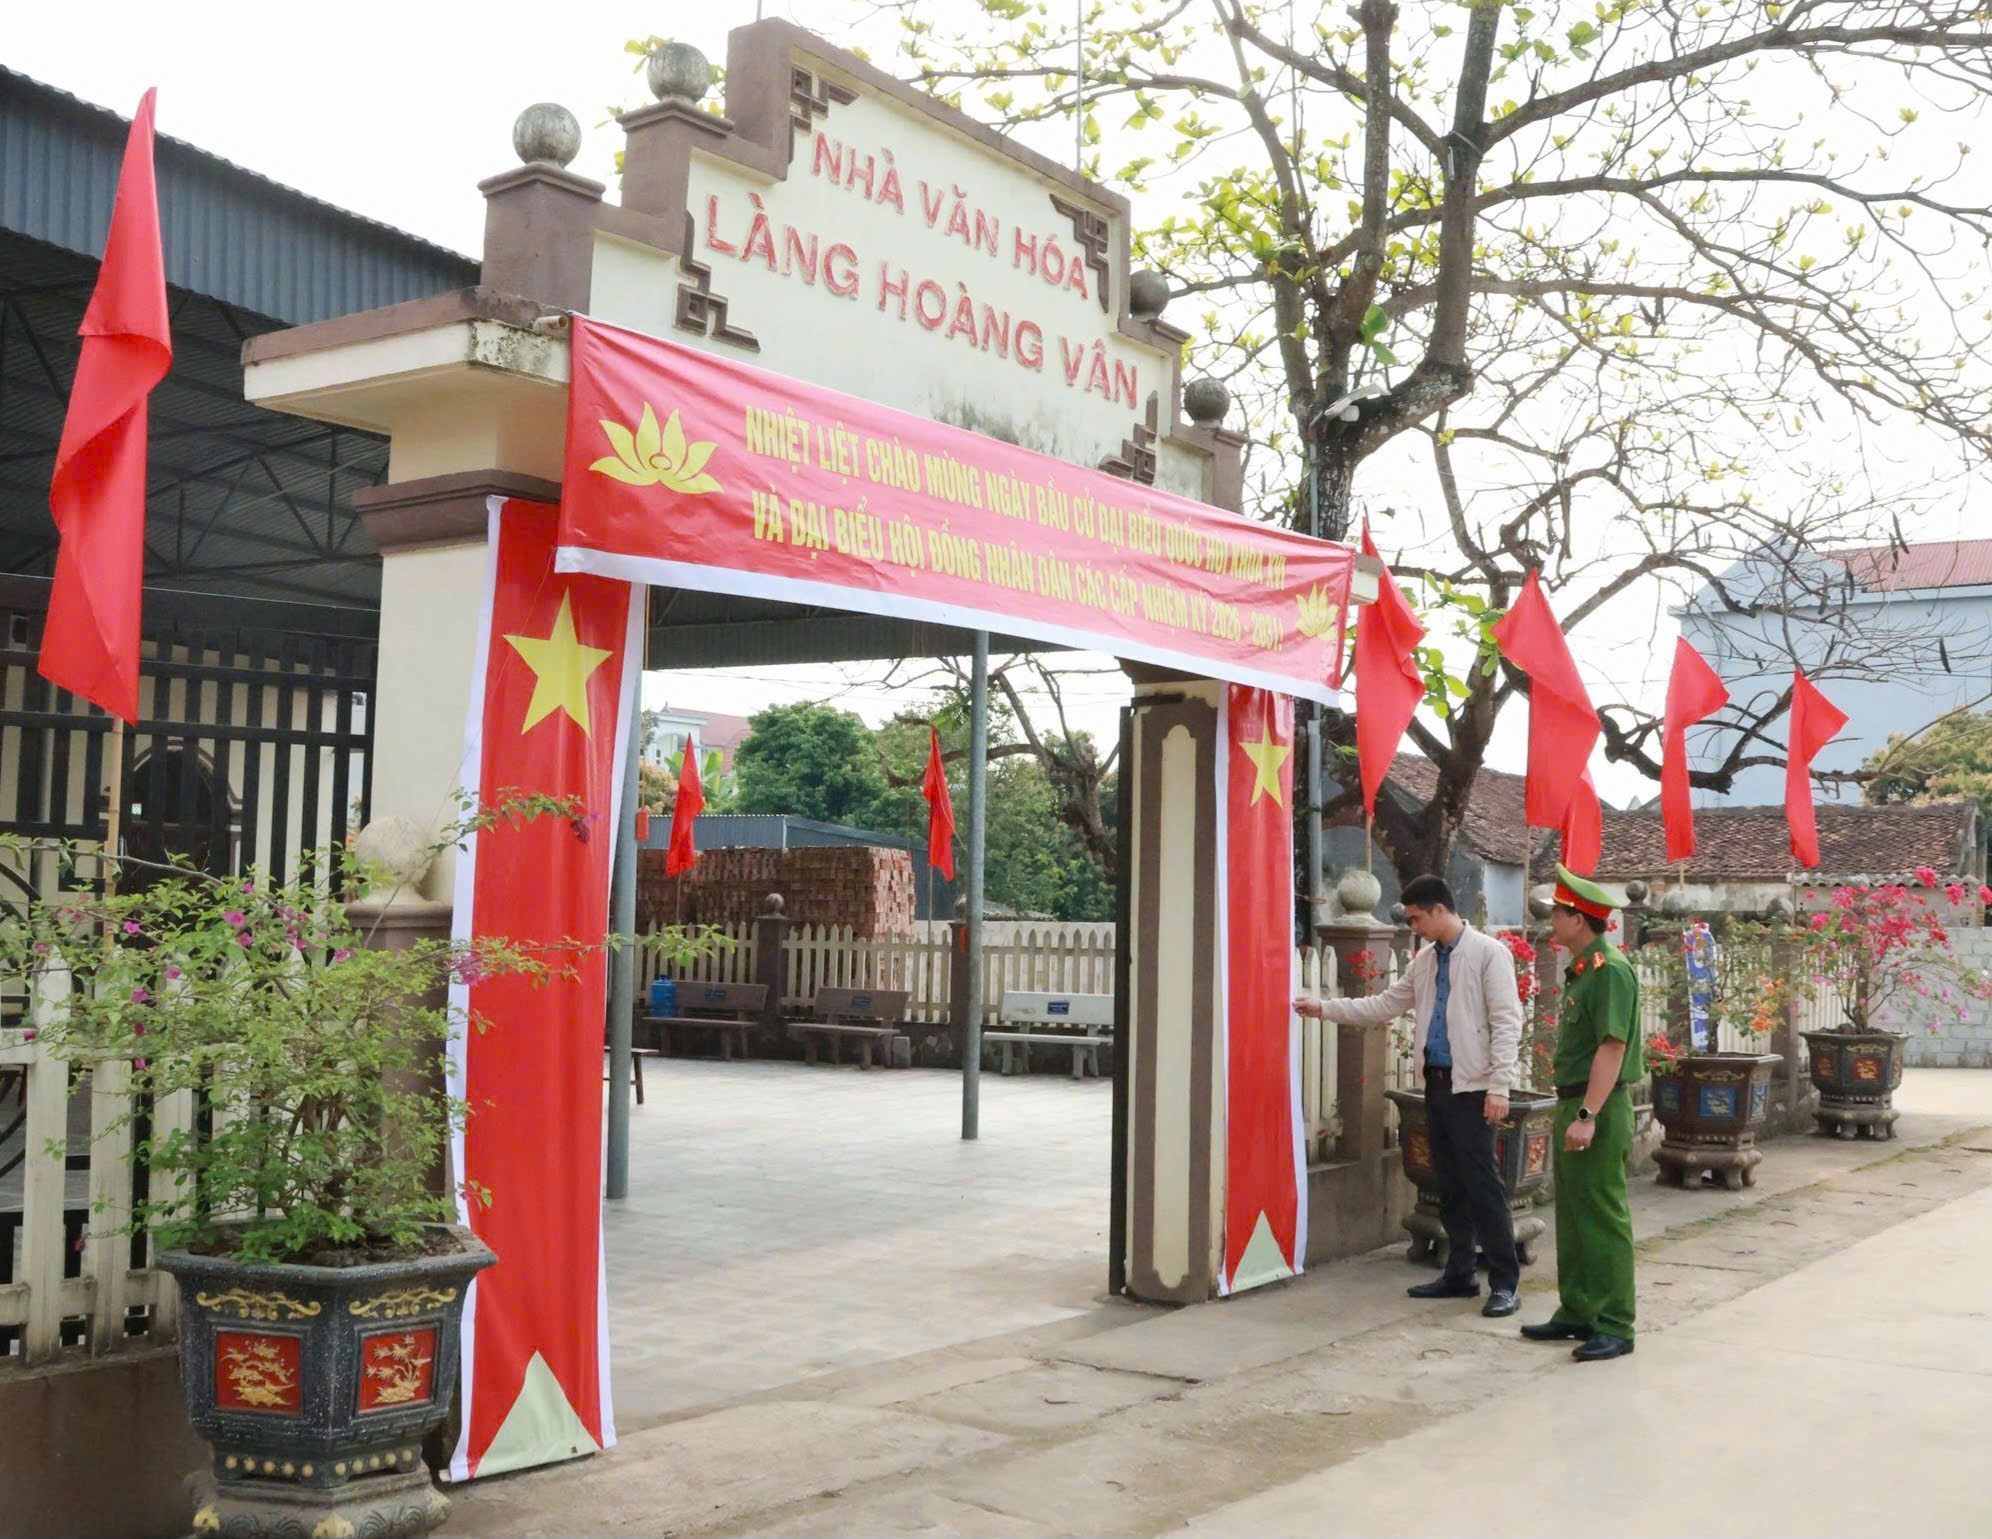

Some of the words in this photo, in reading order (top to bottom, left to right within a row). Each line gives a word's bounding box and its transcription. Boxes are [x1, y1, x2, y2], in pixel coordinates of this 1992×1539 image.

[706, 192, 859, 299] LÀNG
[879, 261, 1044, 372] HOÀNG
[1060, 336, 1138, 409] VÂN
[812, 131, 904, 213] NHÀ
[920, 180, 999, 255] VĂN
[1013, 225, 1088, 299] HÓA
[745, 405, 810, 473] NHIỆT
[817, 421, 860, 484] LIỆT
[866, 436, 921, 493] CHÀO
[924, 450, 983, 509] MỪNG
[984, 469, 1031, 521] NGÀY
[1035, 475, 1070, 531] BẦU
[1073, 487, 1095, 539] CỬ
[1128, 502, 1161, 557] BIỂU
[1165, 516, 1203, 569] QUỐC
[1206, 530, 1228, 580] HỘI
[751, 482, 783, 543] VÀ
[790, 498, 829, 559] ĐẠI
[834, 495, 884, 561] BIỂU
[888, 513, 925, 577] HỘI
[928, 518, 983, 582] ĐỒNG
[984, 540, 1035, 593] NHÂN
[1074, 560, 1107, 610] CÁC
[1109, 563, 1139, 617] CẤP
[1142, 581, 1188, 635] NHIỆM
